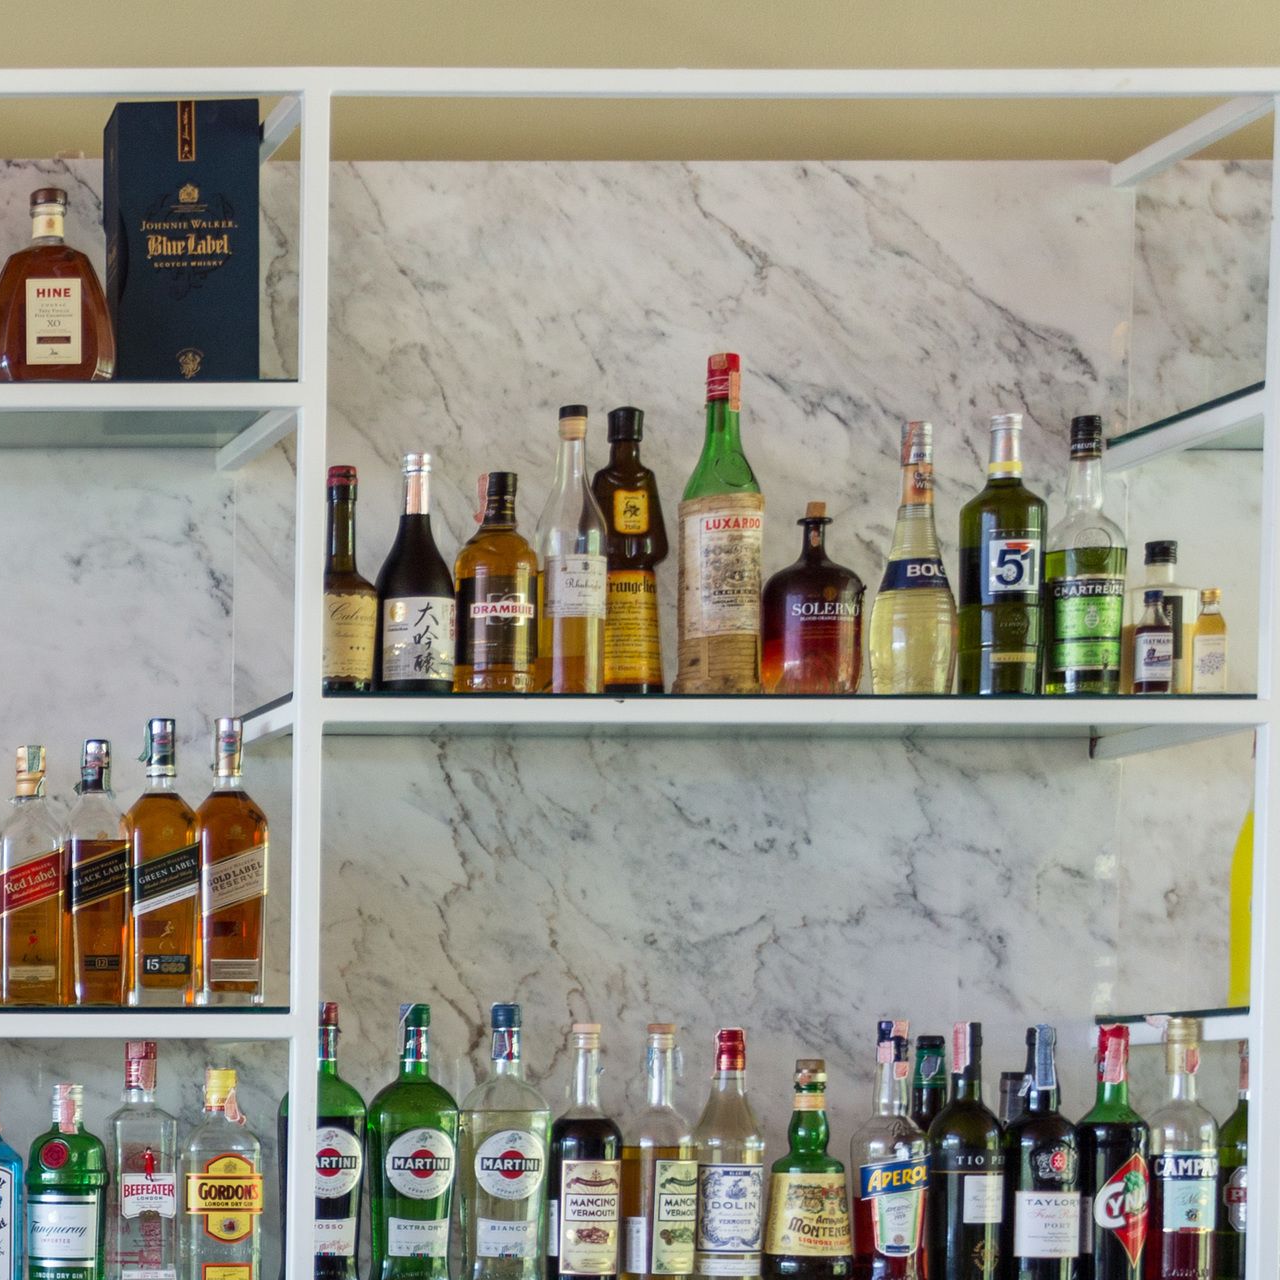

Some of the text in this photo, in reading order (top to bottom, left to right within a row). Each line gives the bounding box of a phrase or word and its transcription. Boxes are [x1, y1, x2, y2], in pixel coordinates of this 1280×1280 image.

[140, 221, 188, 231] JOHNNIE
[147, 234, 185, 259] Blue
[36, 288, 71, 298] HINE
[47, 319, 61, 328] XO
[705, 517, 761, 531] LUXARDO
[1054, 584, 1123, 598] CHARTREUSE
[473, 605, 533, 615] DRAMBUIE
[792, 603, 860, 617] SOLERNO
[103, 862, 129, 879] LABEL
[139, 859, 197, 885] GREEN LABEL
[207, 863, 262, 888] GOLD LABEL
[5, 868, 57, 894] Red Label
[211, 871, 260, 893] RESERVE
[146, 959, 159, 970] 15
[393, 1158, 449, 1170] MARTINI
[482, 1158, 539, 1171] MARTINI
[956, 1156, 984, 1165] TIO
[867, 1165, 927, 1192] APEROL
[123, 1184, 175, 1197] BEEFEATER
[198, 1183, 259, 1200] GORDON'S
[570, 1198, 615, 1207] MANCINO
[712, 1202, 756, 1210] DOLIN
[571, 1209, 615, 1217] VERMOUTH
[30, 1220, 87, 1238] Tanqueray
